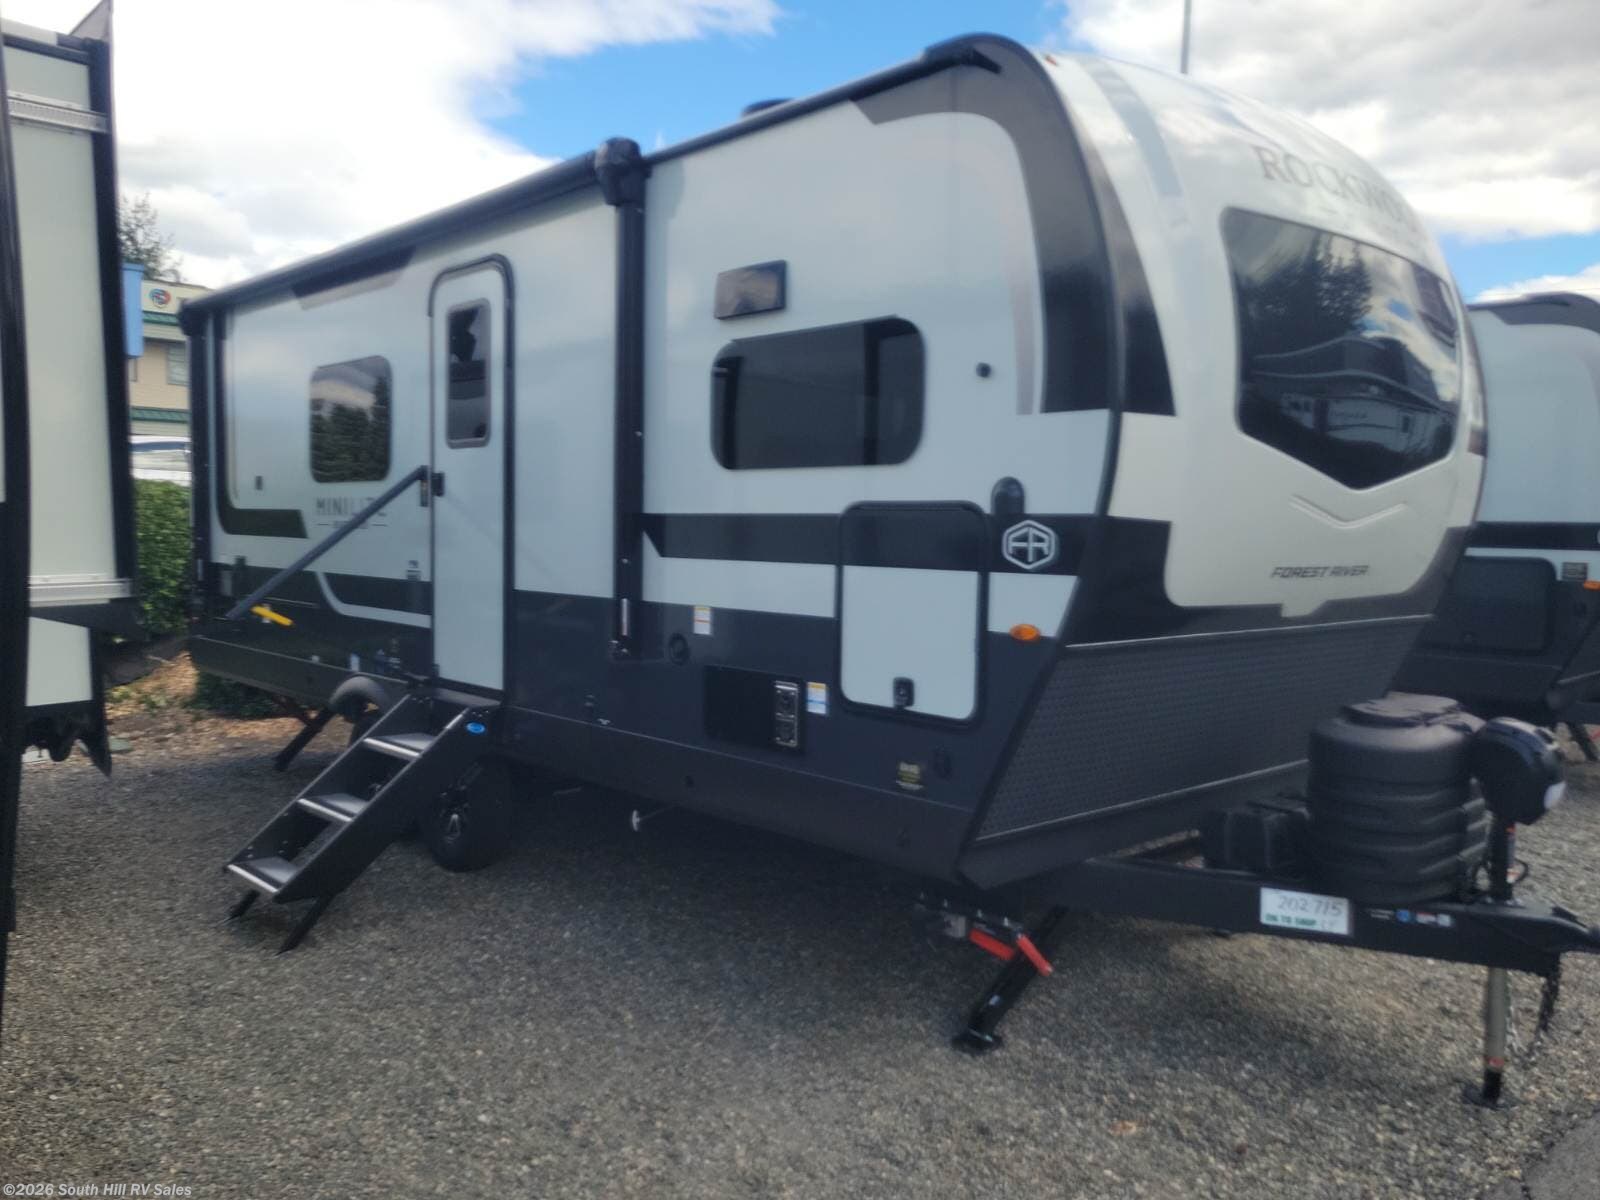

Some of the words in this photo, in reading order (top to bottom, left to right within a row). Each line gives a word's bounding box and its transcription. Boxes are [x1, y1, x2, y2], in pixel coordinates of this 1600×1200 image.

[316, 496, 349, 516] MINI
[1270, 566, 1330, 579] FOREST
[1329, 564, 1370, 577] RIVER
